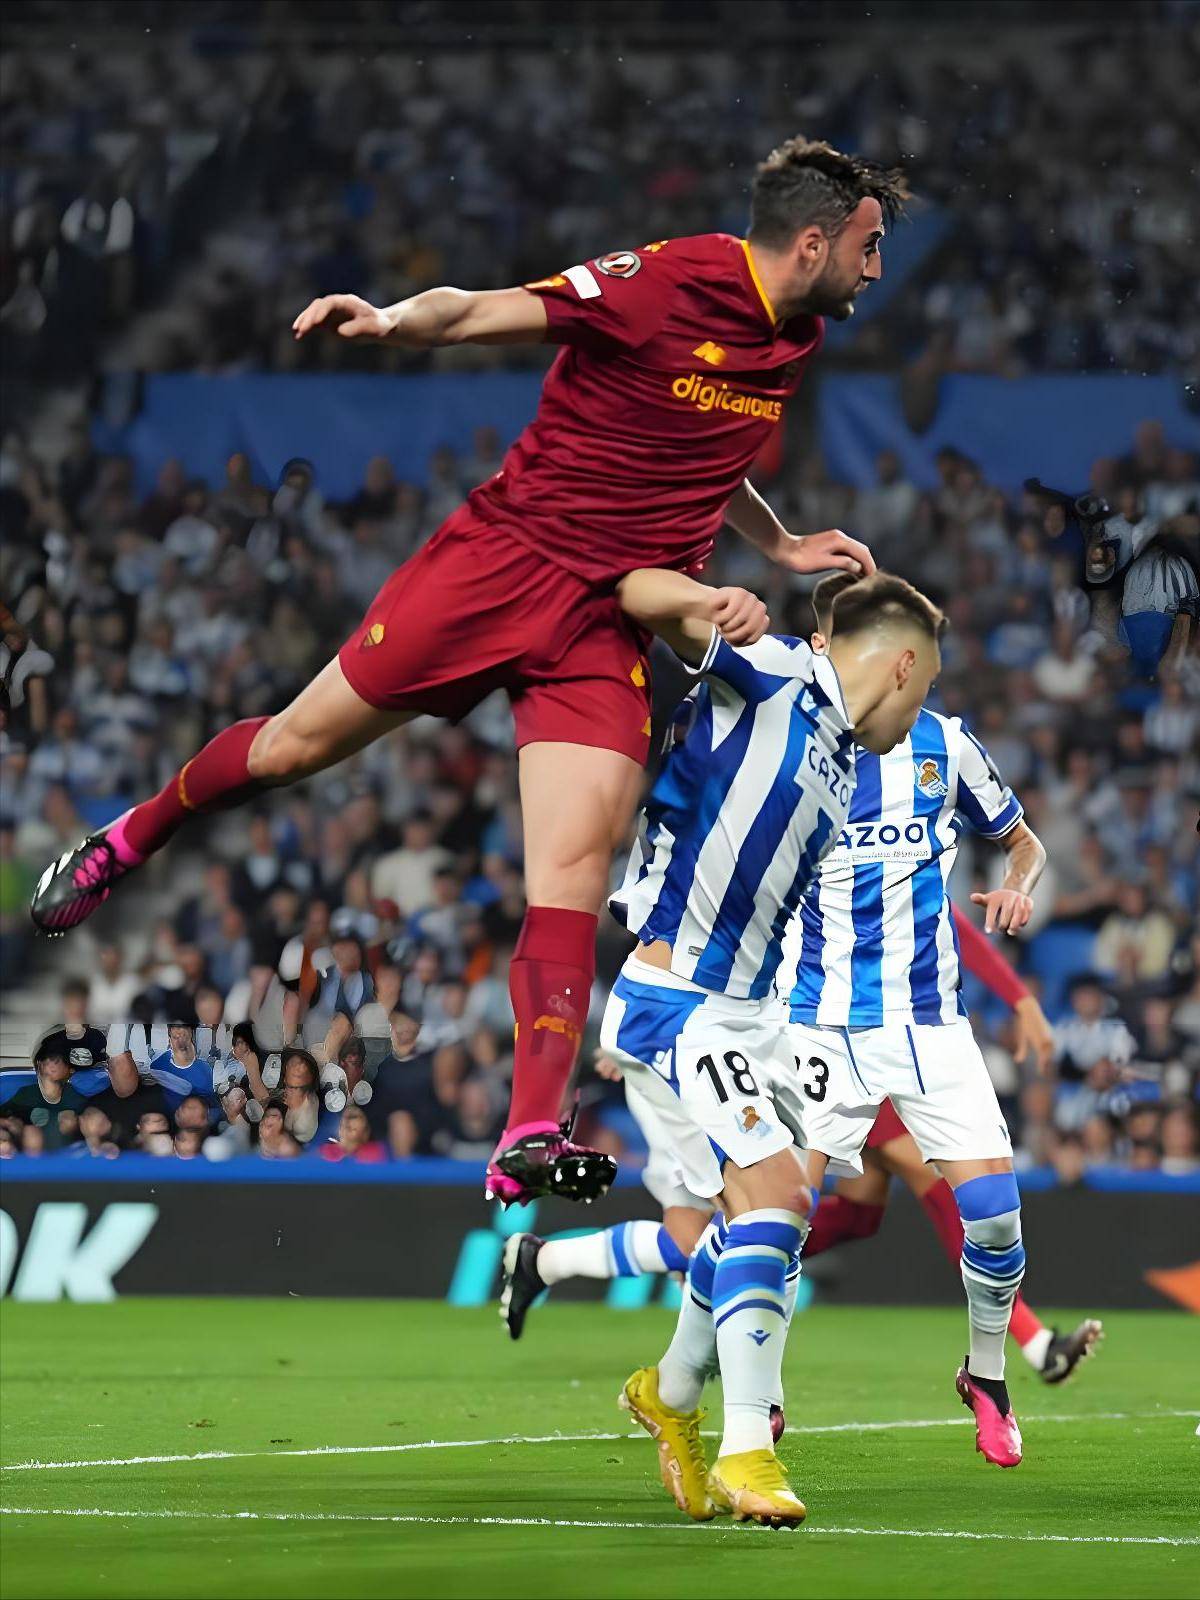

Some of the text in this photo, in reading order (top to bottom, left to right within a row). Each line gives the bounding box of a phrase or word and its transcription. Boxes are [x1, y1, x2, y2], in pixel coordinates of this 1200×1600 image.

[808, 746, 849, 808] CAZO
[836, 822, 924, 850] AZOO
[696, 1051, 760, 1103] 18
[794, 1056, 830, 1102] 3
[0, 1202, 160, 1303] K
